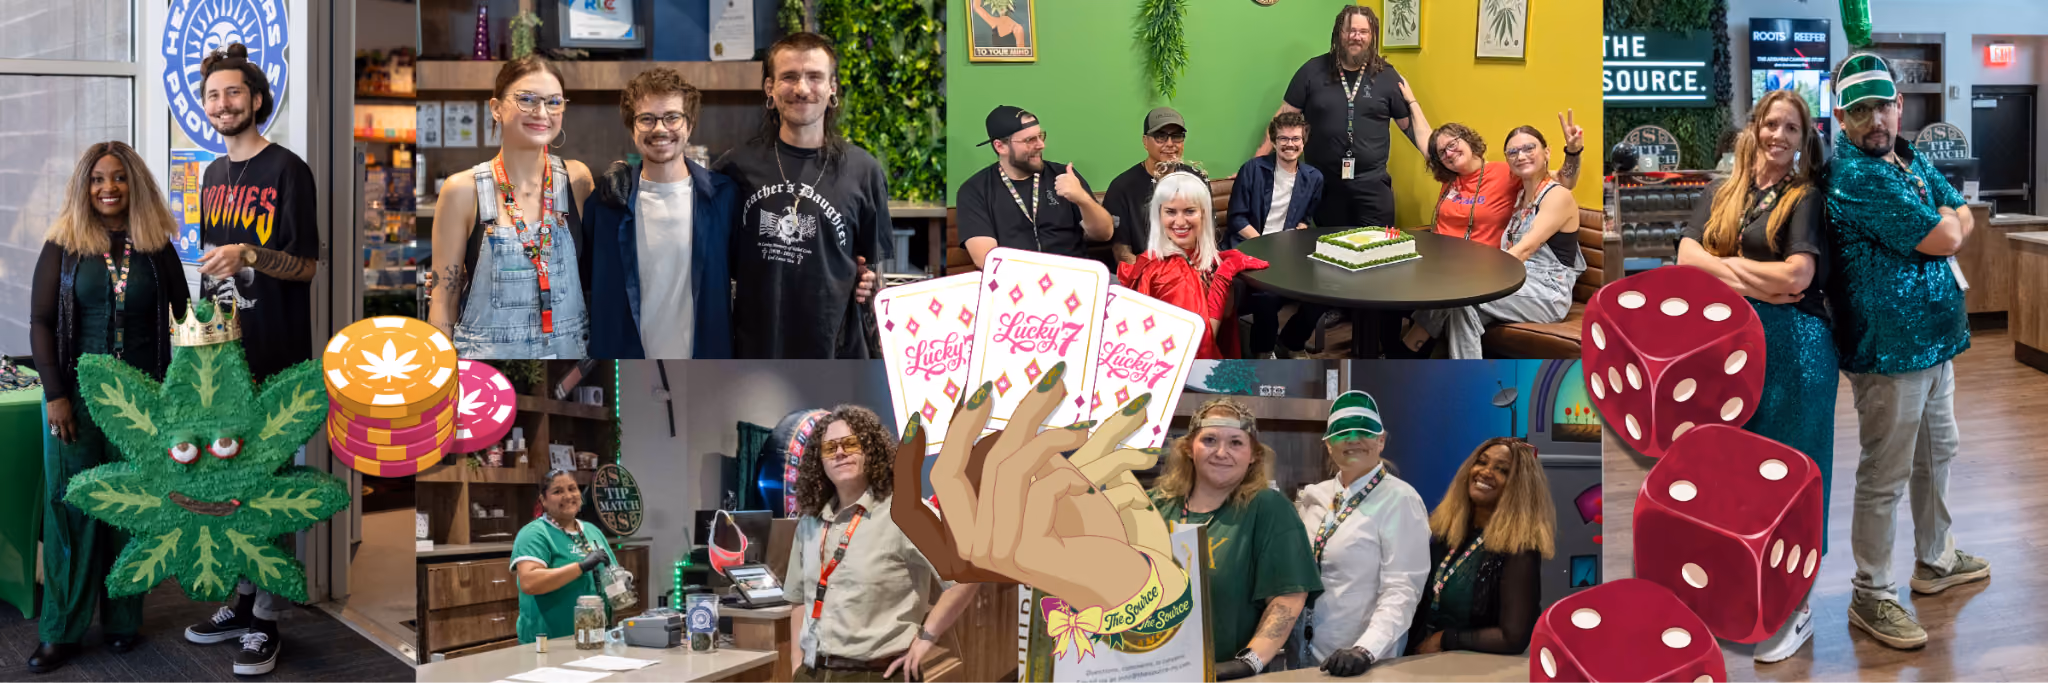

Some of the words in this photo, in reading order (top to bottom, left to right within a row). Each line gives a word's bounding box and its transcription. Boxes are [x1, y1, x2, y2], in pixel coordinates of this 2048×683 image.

[1753, 31, 1786, 41] ROOTS
[1794, 32, 1826, 42] REEFER
[1602, 35, 1646, 57] THE
[1602, 69, 1707, 92] SOURCE.
[1928, 141, 1955, 151] TIP
[1644, 156, 1653, 168] 3
[799, 182, 847, 247] Daughter
[604, 487, 629, 499] TIP
[600, 500, 640, 511] MATCH
